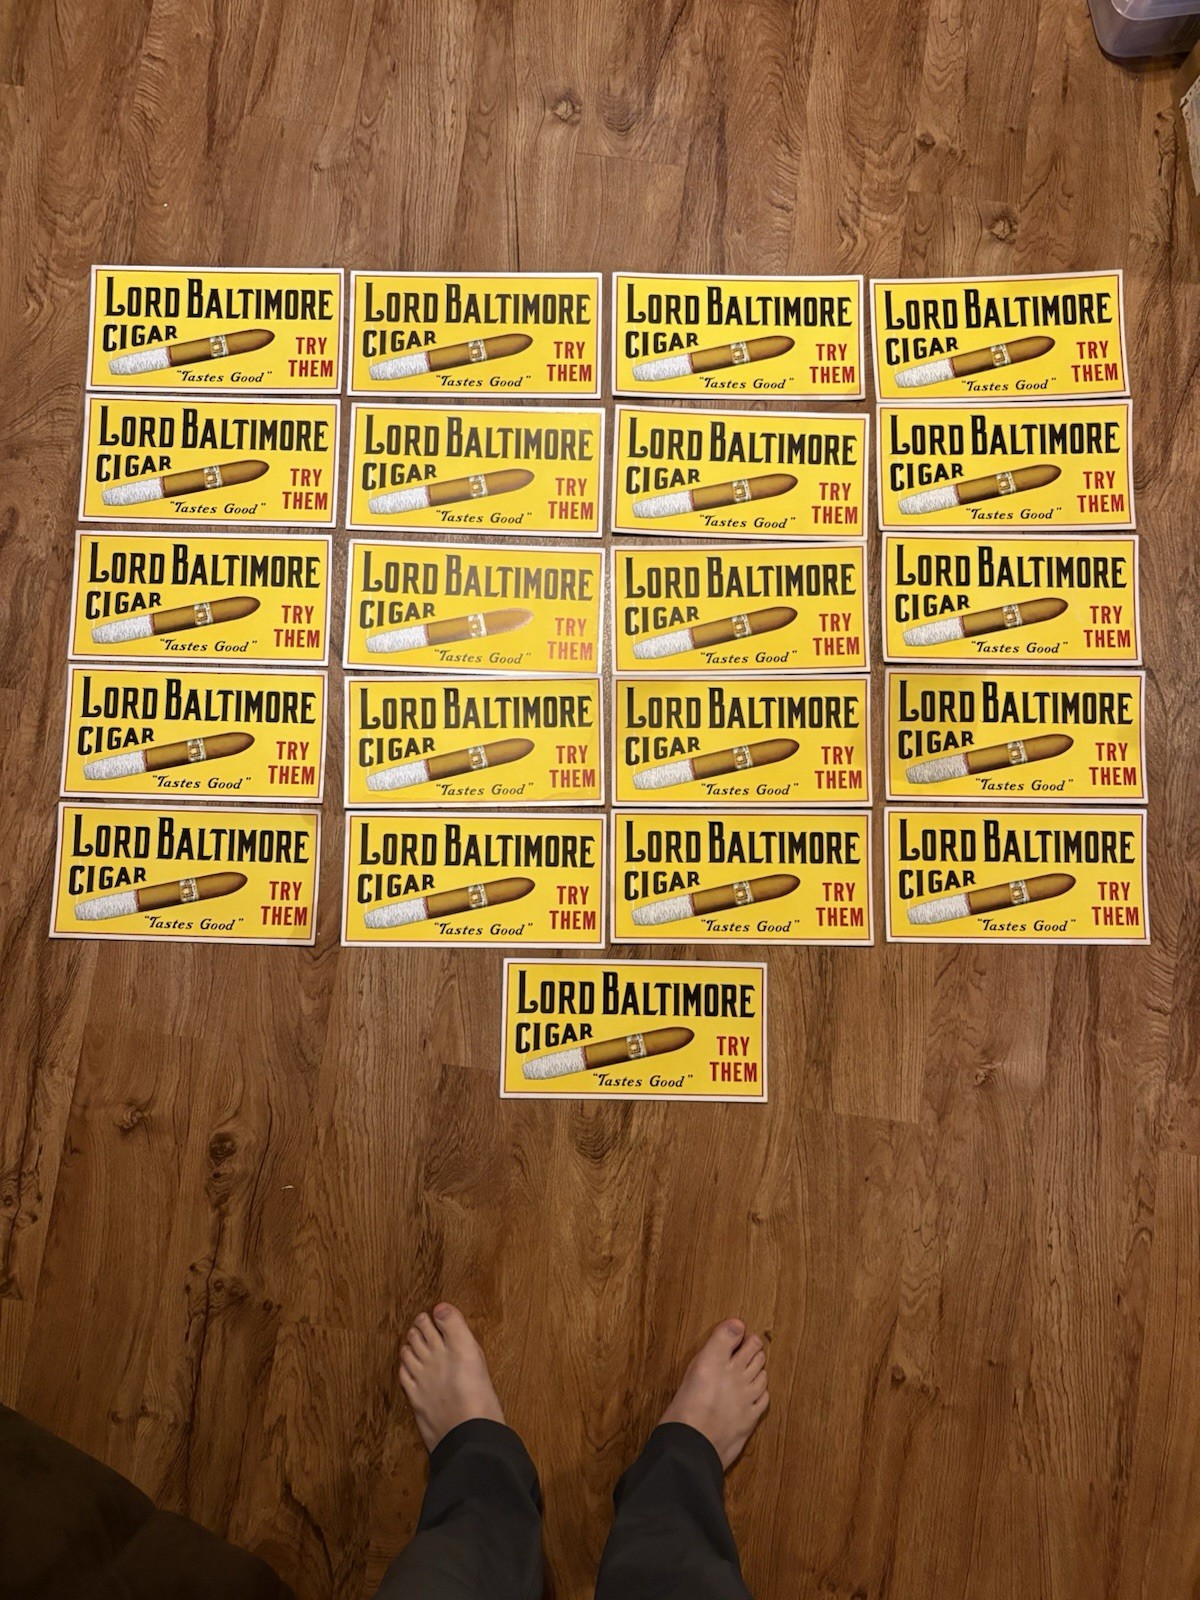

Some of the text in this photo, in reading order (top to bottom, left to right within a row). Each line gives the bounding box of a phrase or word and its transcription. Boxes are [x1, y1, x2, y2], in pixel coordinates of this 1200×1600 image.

[104, 276, 335, 321] LORD BALTIMORE
[363, 282, 592, 326] LORD BALTIMORE
[625, 284, 853, 328] LORD BALTIMORE
[883, 288, 1114, 332] LORD BALTIMORE
[102, 324, 179, 354] CIGAR
[295, 336, 328, 356] TRY
[362, 329, 438, 359] CIGAR
[553, 340, 586, 360] TRY
[625, 331, 700, 361] CIGAR
[1076, 340, 1109, 360] TRY
[815, 343, 848, 362] TRY
[885, 336, 960, 368] CIGAR
[288, 359, 334, 379] THEM
[546, 363, 592, 383] THEM
[809, 366, 856, 385] THEM
[1071, 363, 1119, 384] THEM
[98, 406, 330, 453] LORD BALTIMORE
[363, 414, 595, 462] LORD BALTIMORE
[889, 414, 1121, 457] LORD BALTIMORE
[627, 418, 859, 467] LORD BALTIMORE
[95, 454, 173, 484] CIGAR
[290, 467, 323, 488] TRY
[361, 462, 438, 492] CIGAR
[890, 462, 965, 493] CIGAR
[1083, 470, 1116, 490] TRY
[555, 477, 588, 497] TRY
[625, 466, 702, 496] CIGAR
[819, 482, 852, 502] TRY
[282, 491, 328, 511] THEM
[547, 500, 594, 521] THEM
[1076, 494, 1125, 514] THEM
[811, 505, 858, 526] THEM
[88, 542, 322, 589] LORD BALTIMORE
[895, 545, 1128, 589] LORD BALTIMORE
[625, 556, 857, 600] LORD BALTIMORE
[85, 590, 163, 621] CIGAR
[281, 604, 315, 625] TRY
[359, 600, 437, 631] CIGAR
[895, 593, 971, 624] CIGAR
[1089, 605, 1123, 625] TRY
[554, 617, 588, 637] TRY
[624, 605, 701, 637] CIGAR
[818, 612, 852, 633] TRY
[273, 628, 321, 649] THEM
[812, 637, 860, 657] THEM
[1083, 629, 1131, 649] THEM
[547, 640, 594, 662] THEM
[80, 676, 318, 725] LORD BALTIMORE
[359, 687, 594, 731] LORD BALTIMORE
[625, 686, 860, 730] LORD BALTIMORE
[898, 680, 1134, 726] LORD BALTIMORE
[77, 726, 156, 757] CIGAR
[276, 740, 310, 761] TRY
[625, 736, 702, 767] CIGAR
[898, 730, 975, 761] CIGAR
[1095, 742, 1129, 762] TRY
[359, 737, 437, 769] CIGAR
[555, 744, 589, 765] TRY
[821, 745, 855, 766] TRY
[267, 765, 316, 786] THEM
[549, 768, 596, 789] THEM
[814, 770, 863, 790] THEM
[1089, 766, 1137, 787] THEM
[71, 814, 311, 865] LORD BALTIMORE
[359, 822, 596, 869] LORD BALTIMORE
[624, 820, 862, 865] LORD BALTIMORE
[899, 818, 1136, 865] LORD BALTIMORE
[68, 865, 148, 897] CIGAR
[269, 880, 303, 902] TRY
[357, 873, 436, 905] CIGAR
[624, 871, 701, 902] CIGAR
[898, 869, 977, 901] CIGAR
[1097, 881, 1131, 902] TRY
[556, 885, 590, 906] TRY
[822, 882, 856, 903] TRY
[260, 905, 309, 927] THEM
[549, 910, 597, 931] THEM
[815, 907, 864, 928] THEM
[1091, 906, 1140, 927] THEM
[516, 970, 756, 1019] LORD BALTIMORE
[515, 1022, 594, 1055] CIGAR
[716, 1035, 751, 1057] TRY
[709, 1061, 758, 1083] THEM
